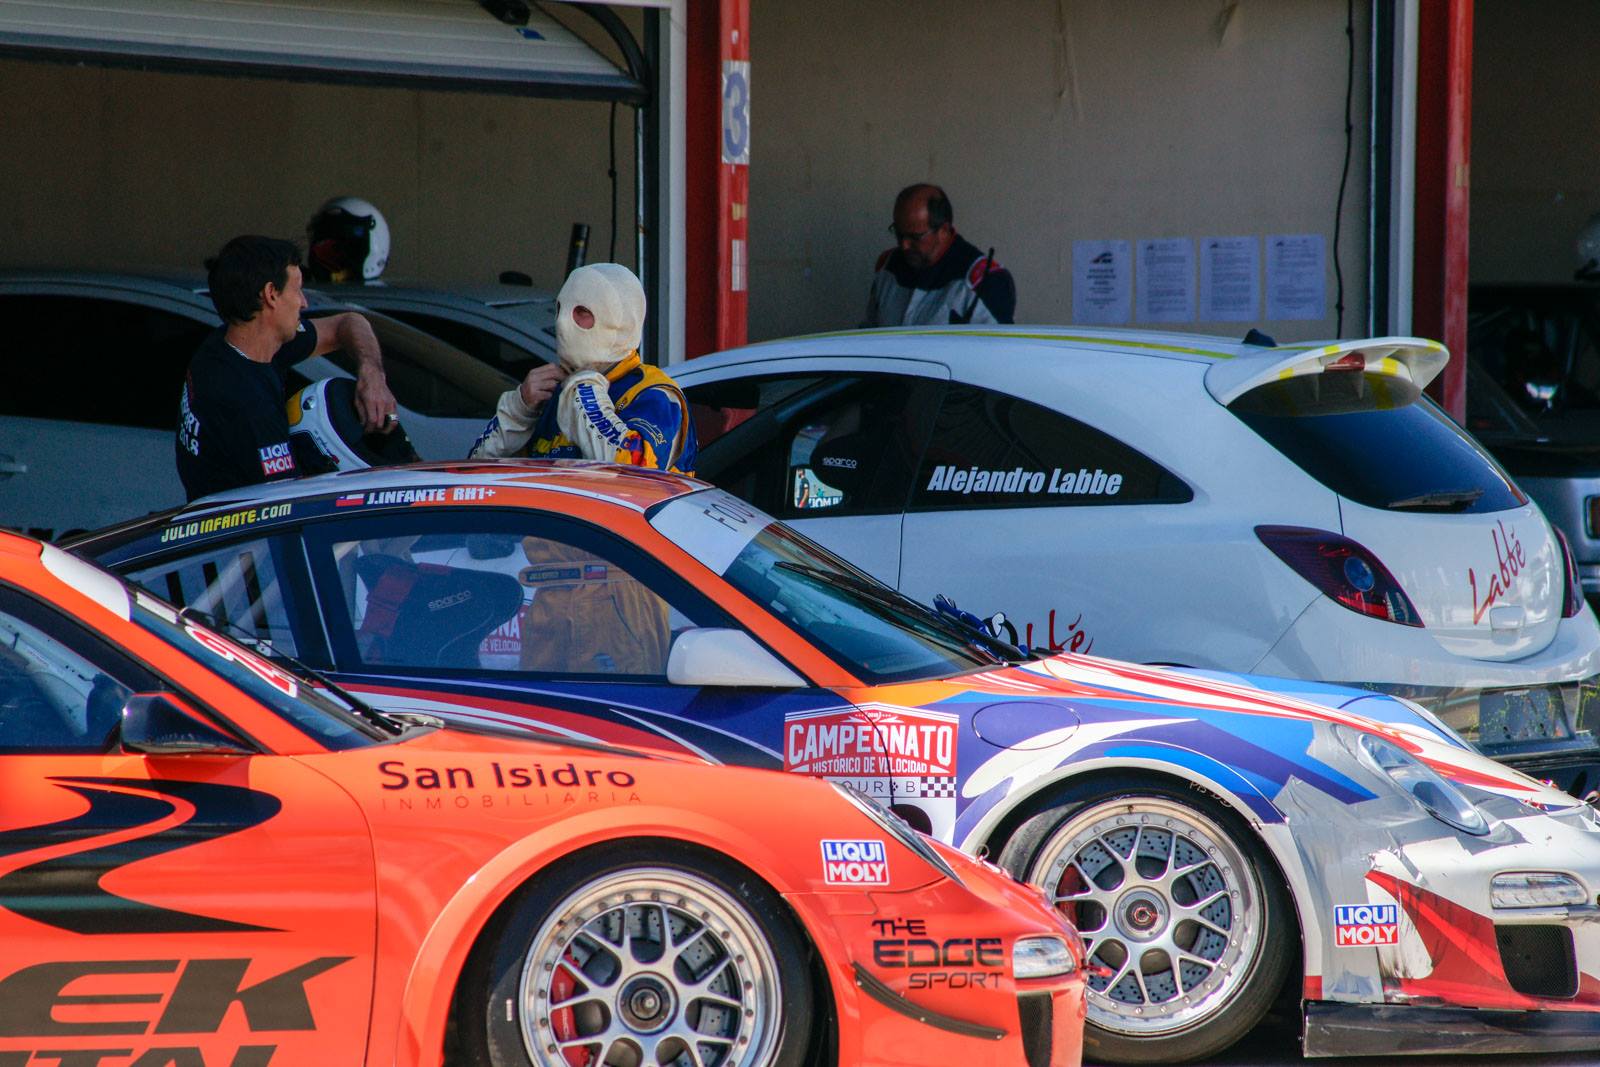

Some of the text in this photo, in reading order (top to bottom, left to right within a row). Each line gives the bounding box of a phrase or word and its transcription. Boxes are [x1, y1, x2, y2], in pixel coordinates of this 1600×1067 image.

[725, 72, 747, 157] 3
[263, 456, 293, 474] MOLY
[927, 466, 1123, 495] Alejandro Labbe
[366, 487, 496, 505] J.INFANTE RH1+
[788, 724, 953, 767] CAMPEONATO
[812, 756, 928, 774] HISTÓRICO DE VELOCIDAD
[378, 761, 636, 790] San Isidro
[382, 792, 641, 810] INMOBILIARIA
[825, 842, 882, 862] LIQUI
[828, 863, 885, 882] MOLY
[1337, 906, 1395, 925] LIQUI
[872, 918, 927, 936] THE
[1339, 926, 1397, 945] MOLY
[873, 938, 1004, 968] EDGE
[909, 972, 1004, 989] SPORT
